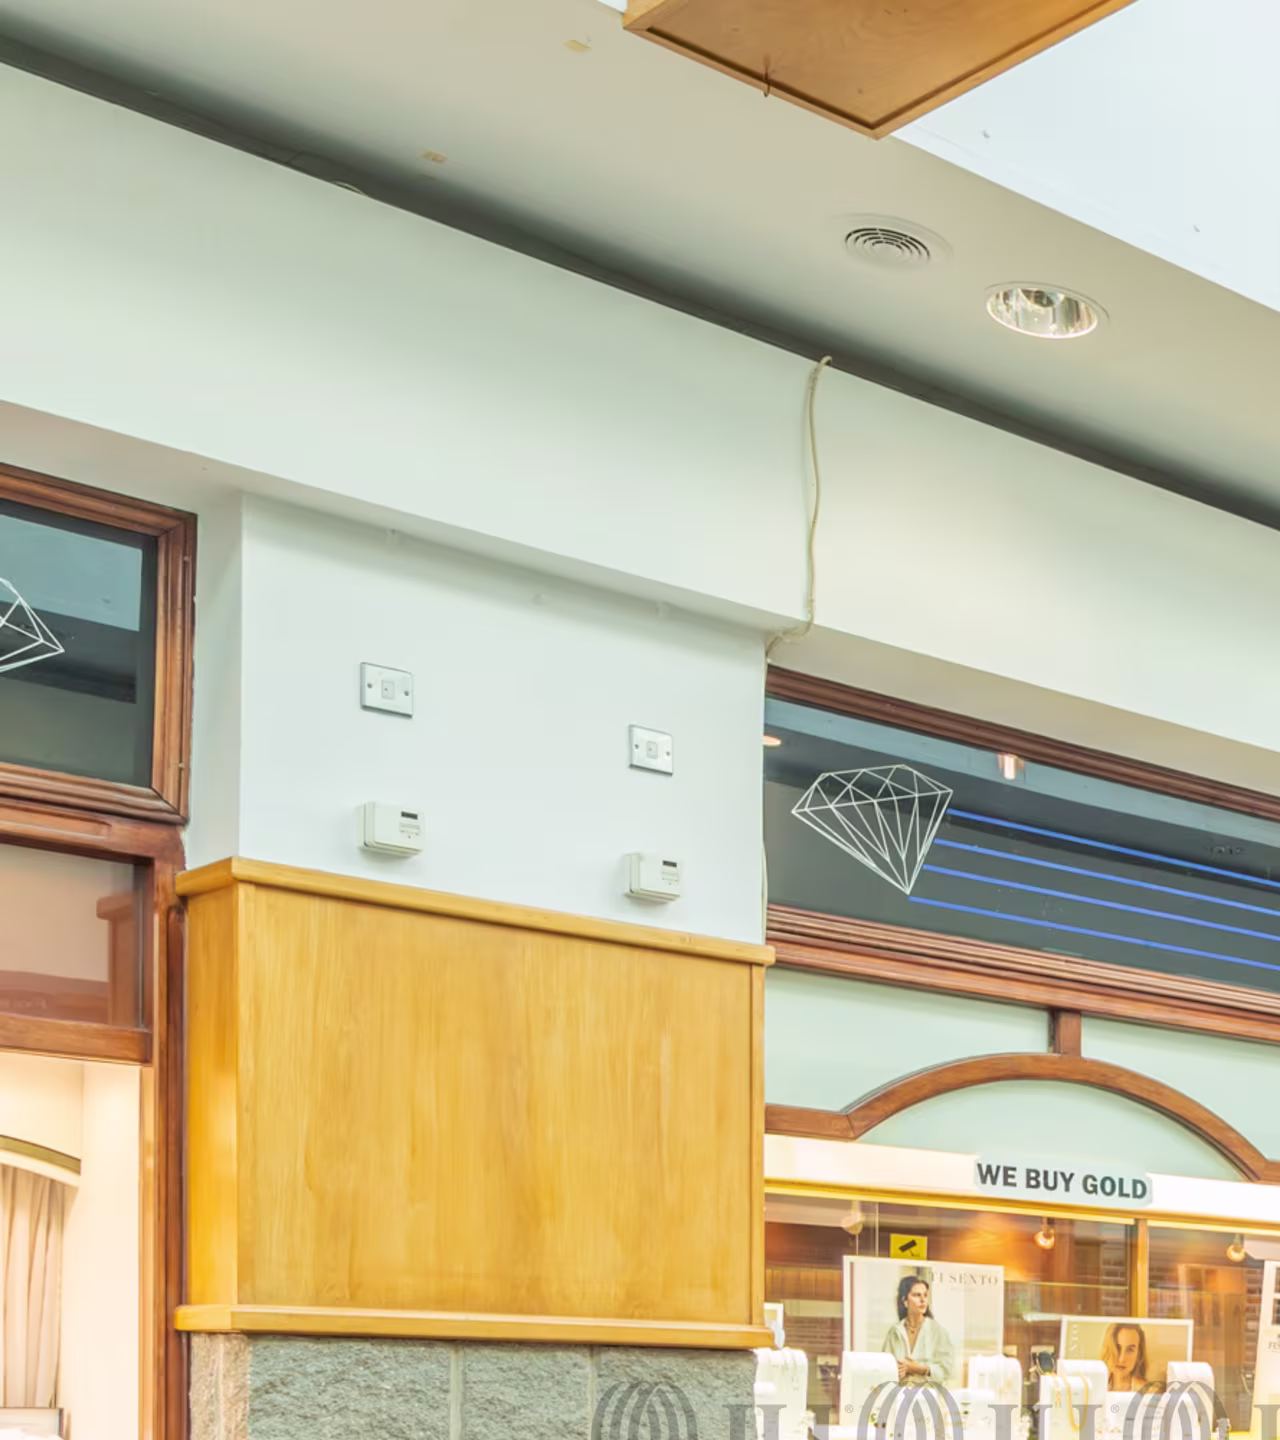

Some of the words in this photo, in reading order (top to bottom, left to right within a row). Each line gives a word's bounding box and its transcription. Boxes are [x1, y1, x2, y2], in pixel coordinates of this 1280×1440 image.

[977, 1163, 1017, 1188] WE
[1025, 1168, 1075, 1193] BUY
[1082, 1174, 1147, 1199] GOLD
[949, 1272, 998, 1286] SENTO
